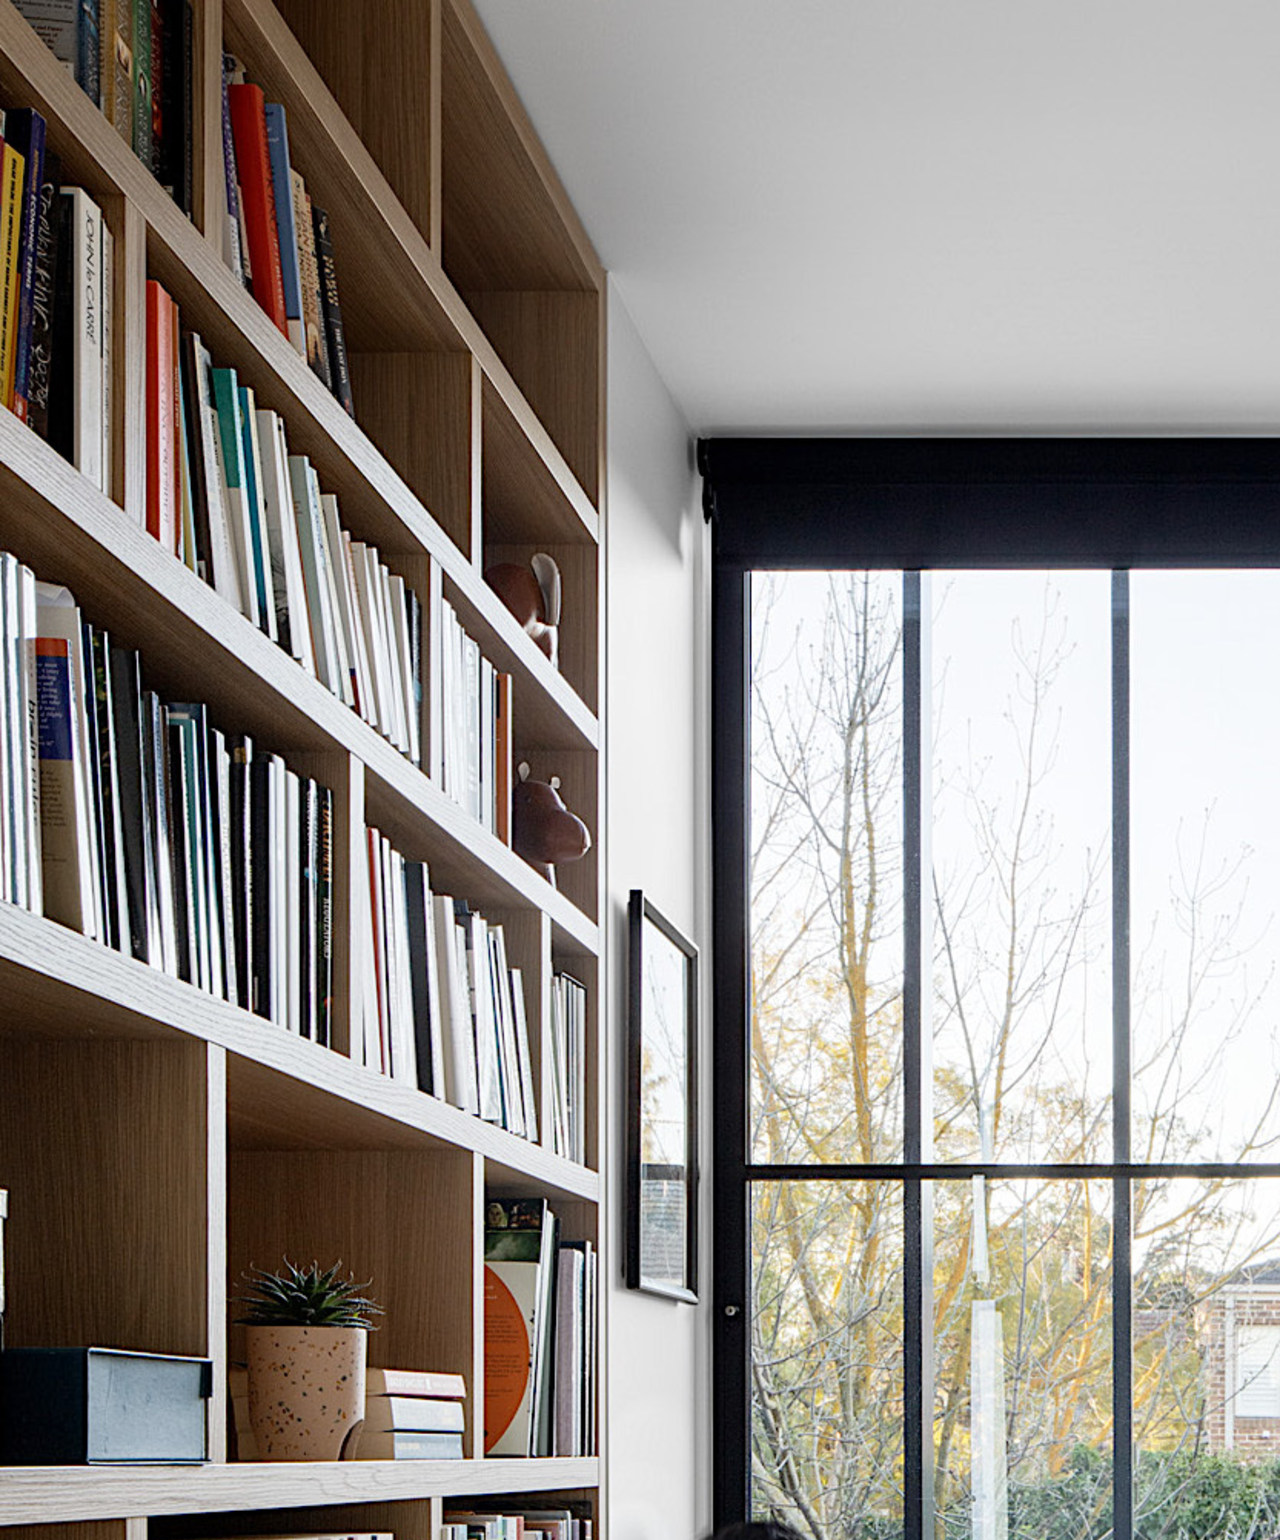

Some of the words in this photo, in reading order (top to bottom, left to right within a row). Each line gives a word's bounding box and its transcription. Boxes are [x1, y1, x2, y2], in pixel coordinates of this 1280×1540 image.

[26, 194, 37, 252] ECONOMIC
[36, 183, 54, 260] STEPHEN
[85, 210, 95, 265] JOHN
[85, 285, 96, 345] CARRÉ
[29, 697, 38, 758] brain
